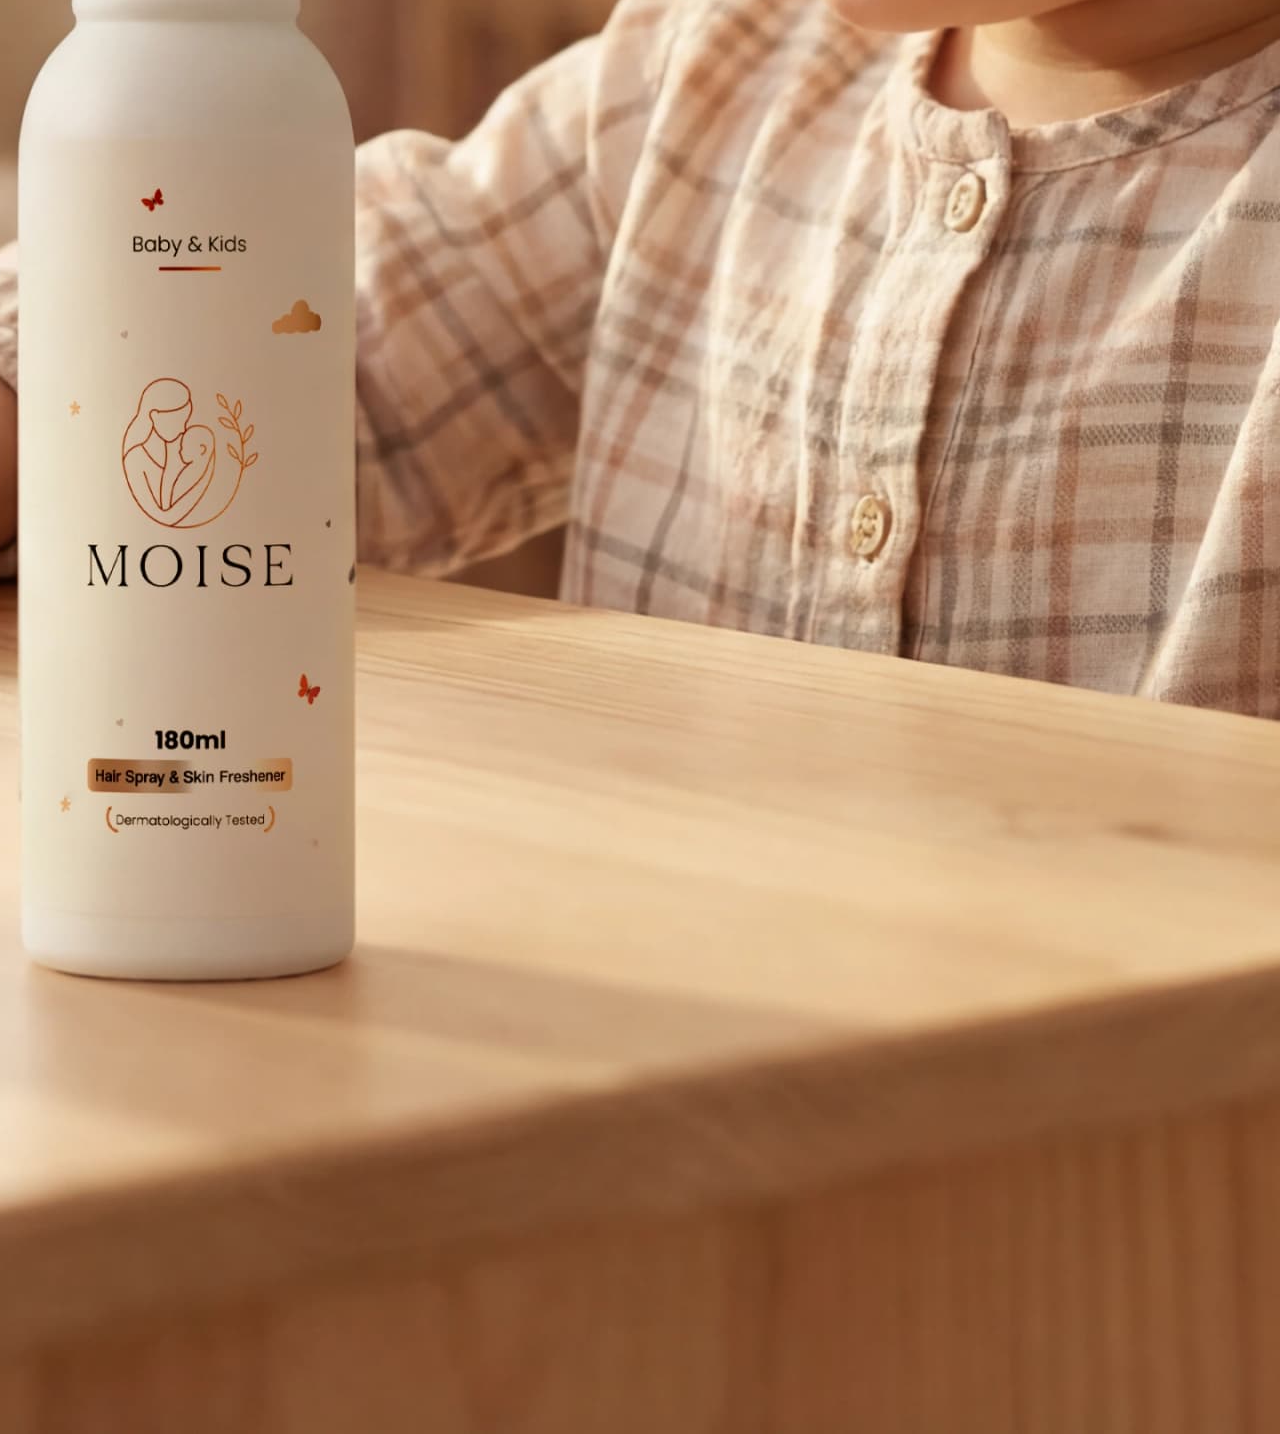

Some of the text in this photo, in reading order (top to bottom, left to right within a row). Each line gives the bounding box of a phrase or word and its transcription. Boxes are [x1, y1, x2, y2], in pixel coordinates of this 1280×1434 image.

[132, 235, 247, 257] Baby & Kids
[87, 543, 293, 588] MOISE
[154, 729, 226, 750] 180ml
[95, 768, 286, 787] Hair Spray & Skin Freshener
